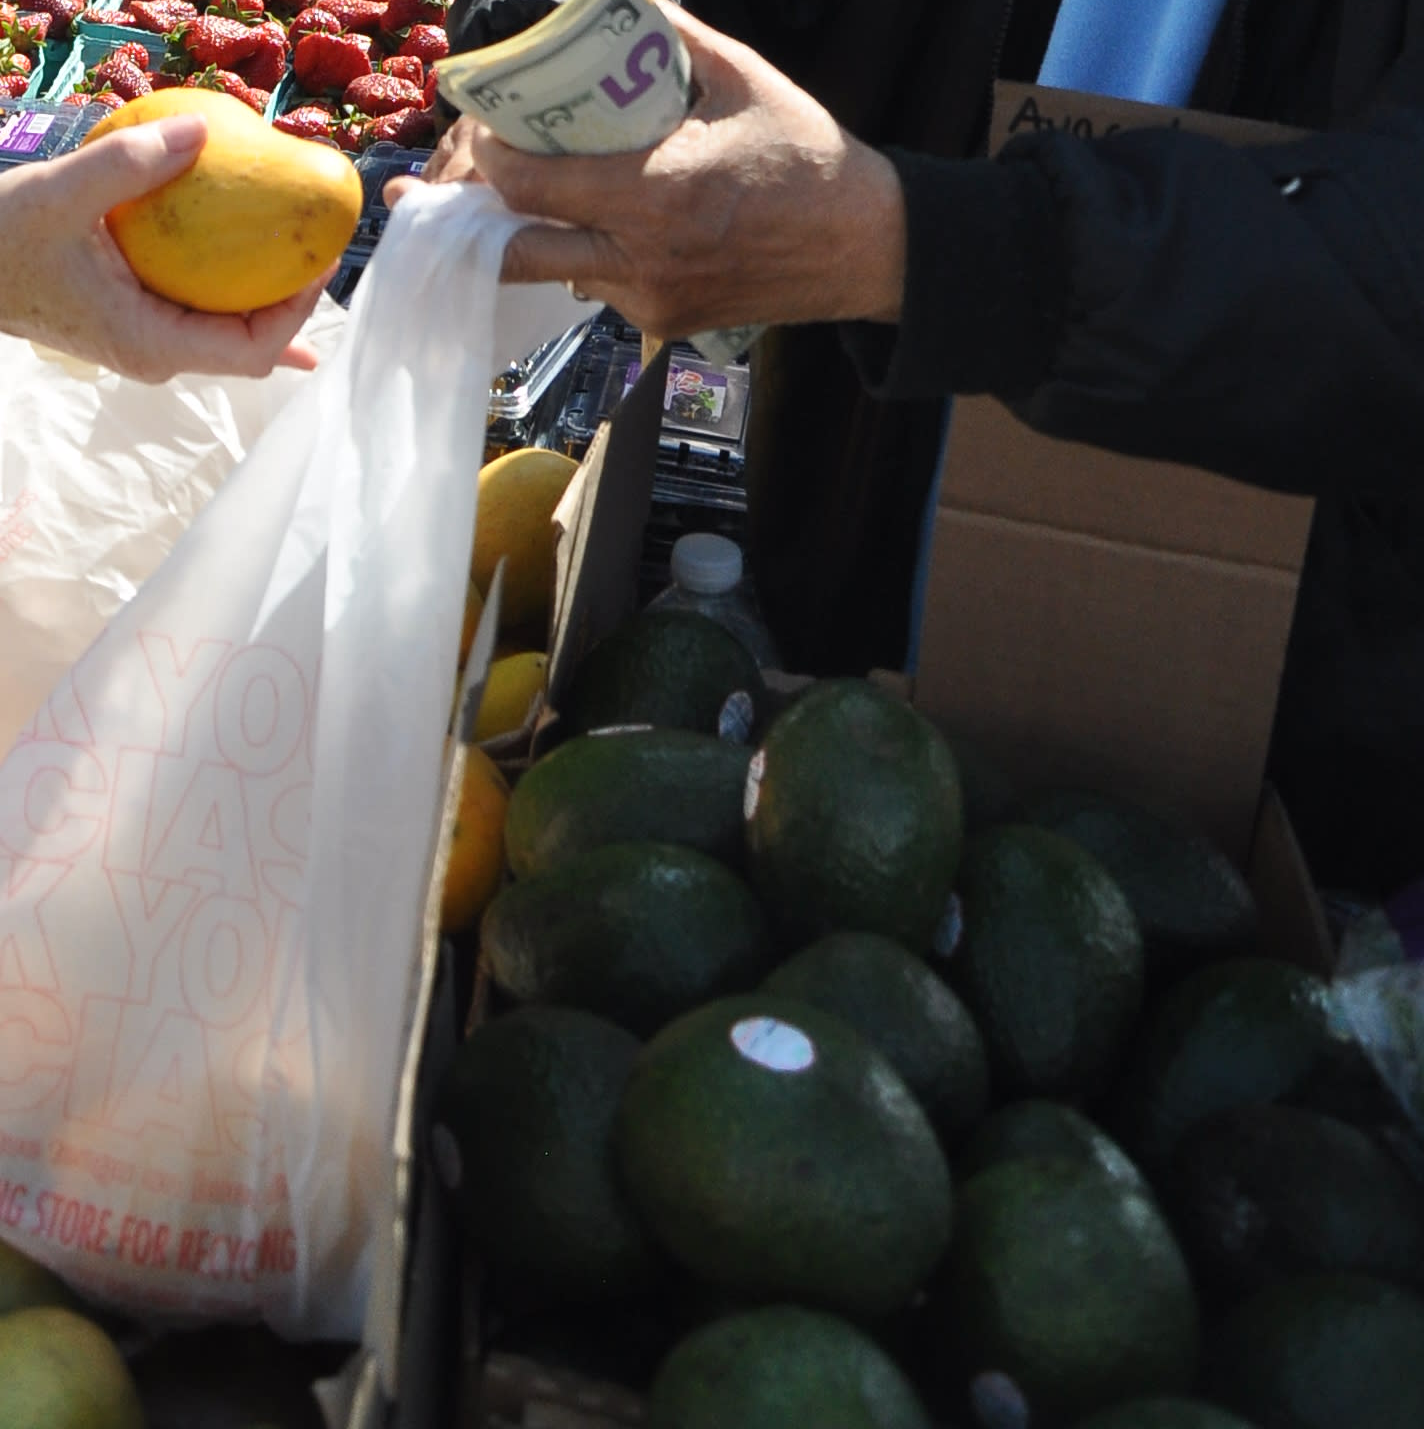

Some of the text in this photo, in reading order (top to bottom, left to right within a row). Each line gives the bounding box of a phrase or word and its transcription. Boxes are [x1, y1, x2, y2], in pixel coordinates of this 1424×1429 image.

[599, 30, 670, 109] 5
[30, 1190, 113, 1257] STORE
[116, 1212, 172, 1270] FOR
[176, 1226, 298, 1283] RECYCNG
